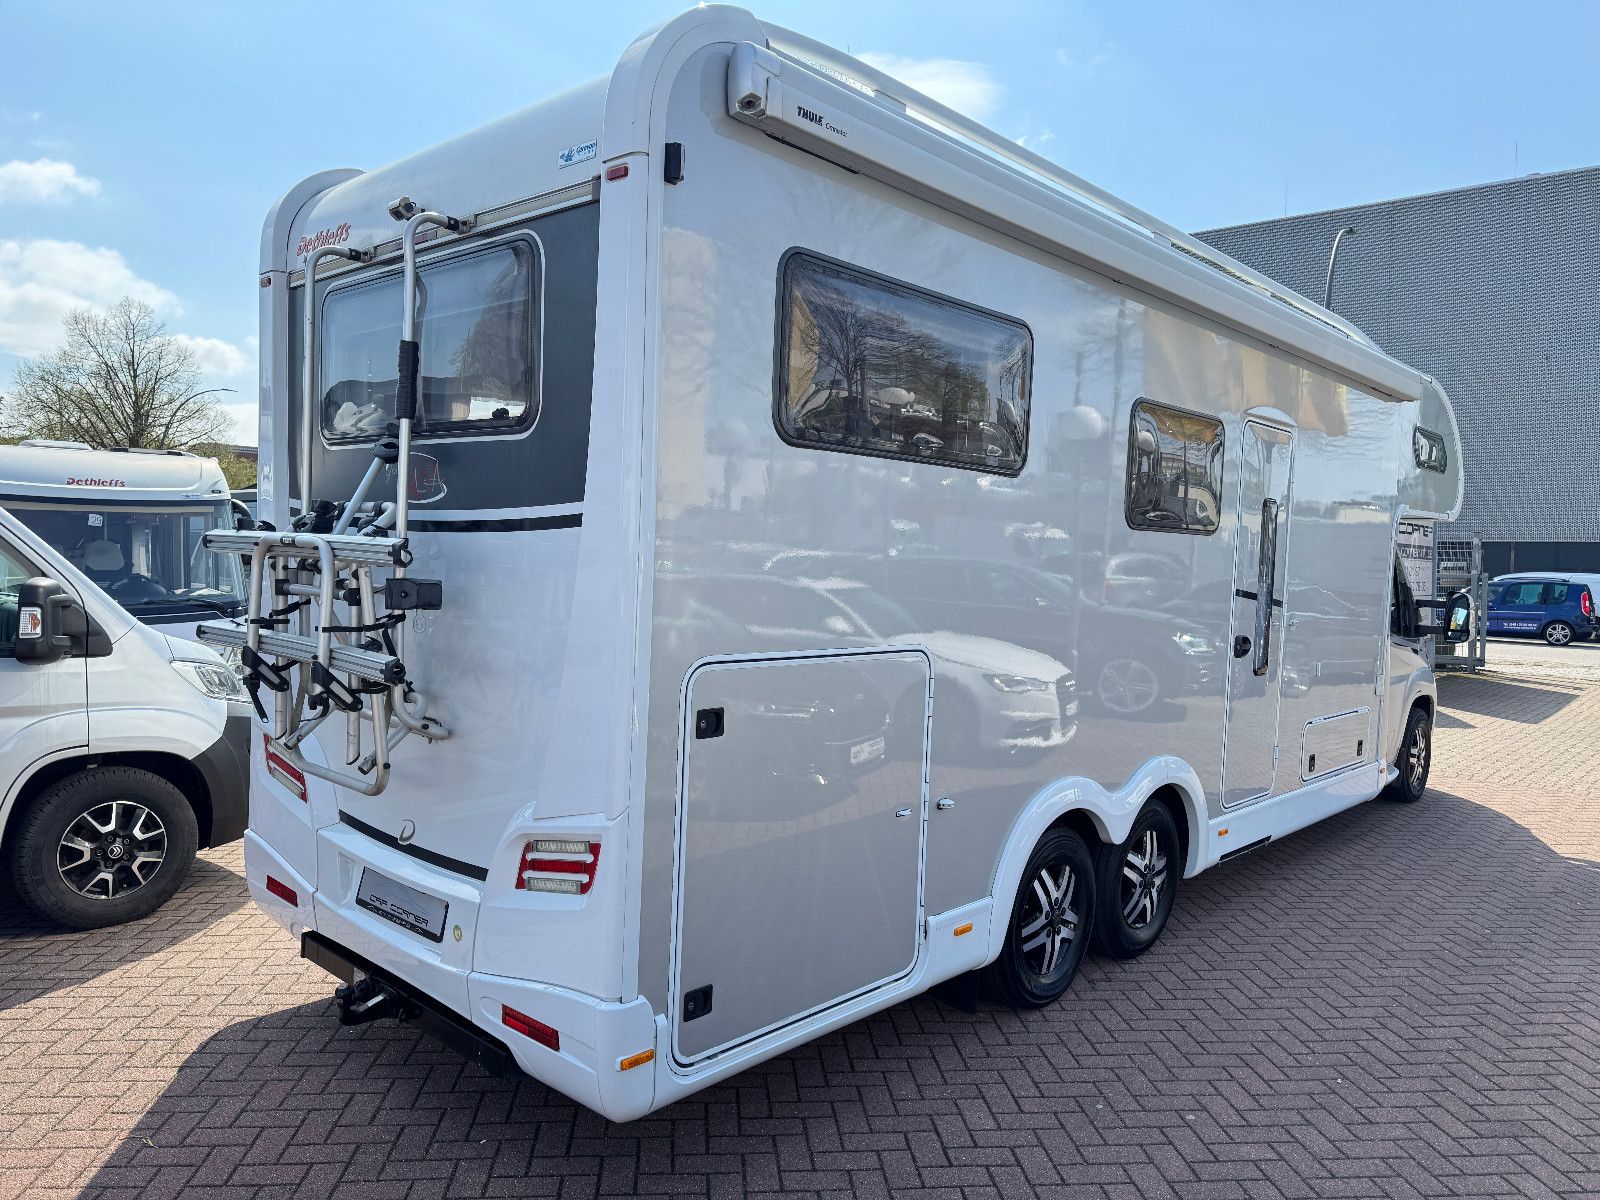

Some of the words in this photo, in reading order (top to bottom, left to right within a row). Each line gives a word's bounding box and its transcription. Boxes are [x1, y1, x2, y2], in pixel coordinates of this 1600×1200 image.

[797, 105, 824, 127] THULE
[296, 222, 352, 257] Dethleffs
[66, 477, 127, 488] Dethleffs
